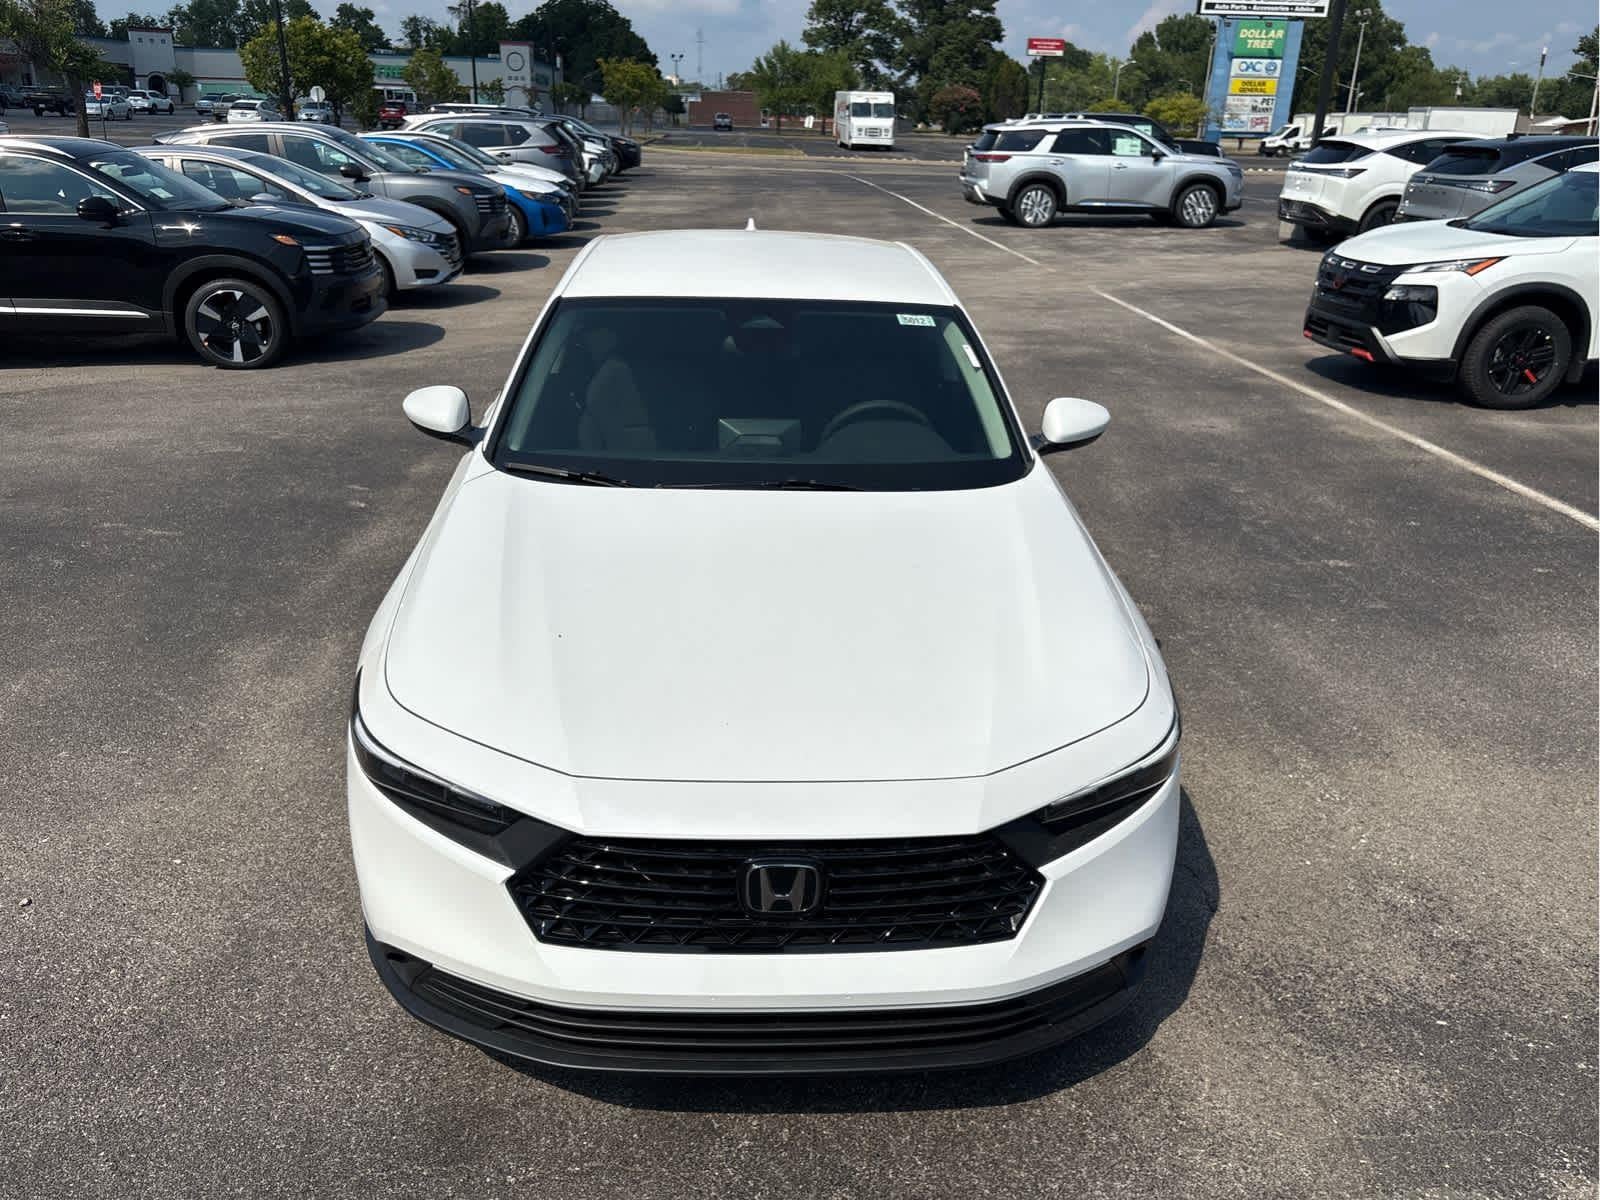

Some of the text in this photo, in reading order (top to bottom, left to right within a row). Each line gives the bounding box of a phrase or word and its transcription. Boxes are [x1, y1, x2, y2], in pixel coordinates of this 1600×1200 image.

[1240, 29, 1284, 38] DOLLAR
[1247, 39, 1274, 48] TREE
[1261, 98, 1274, 106] PET
